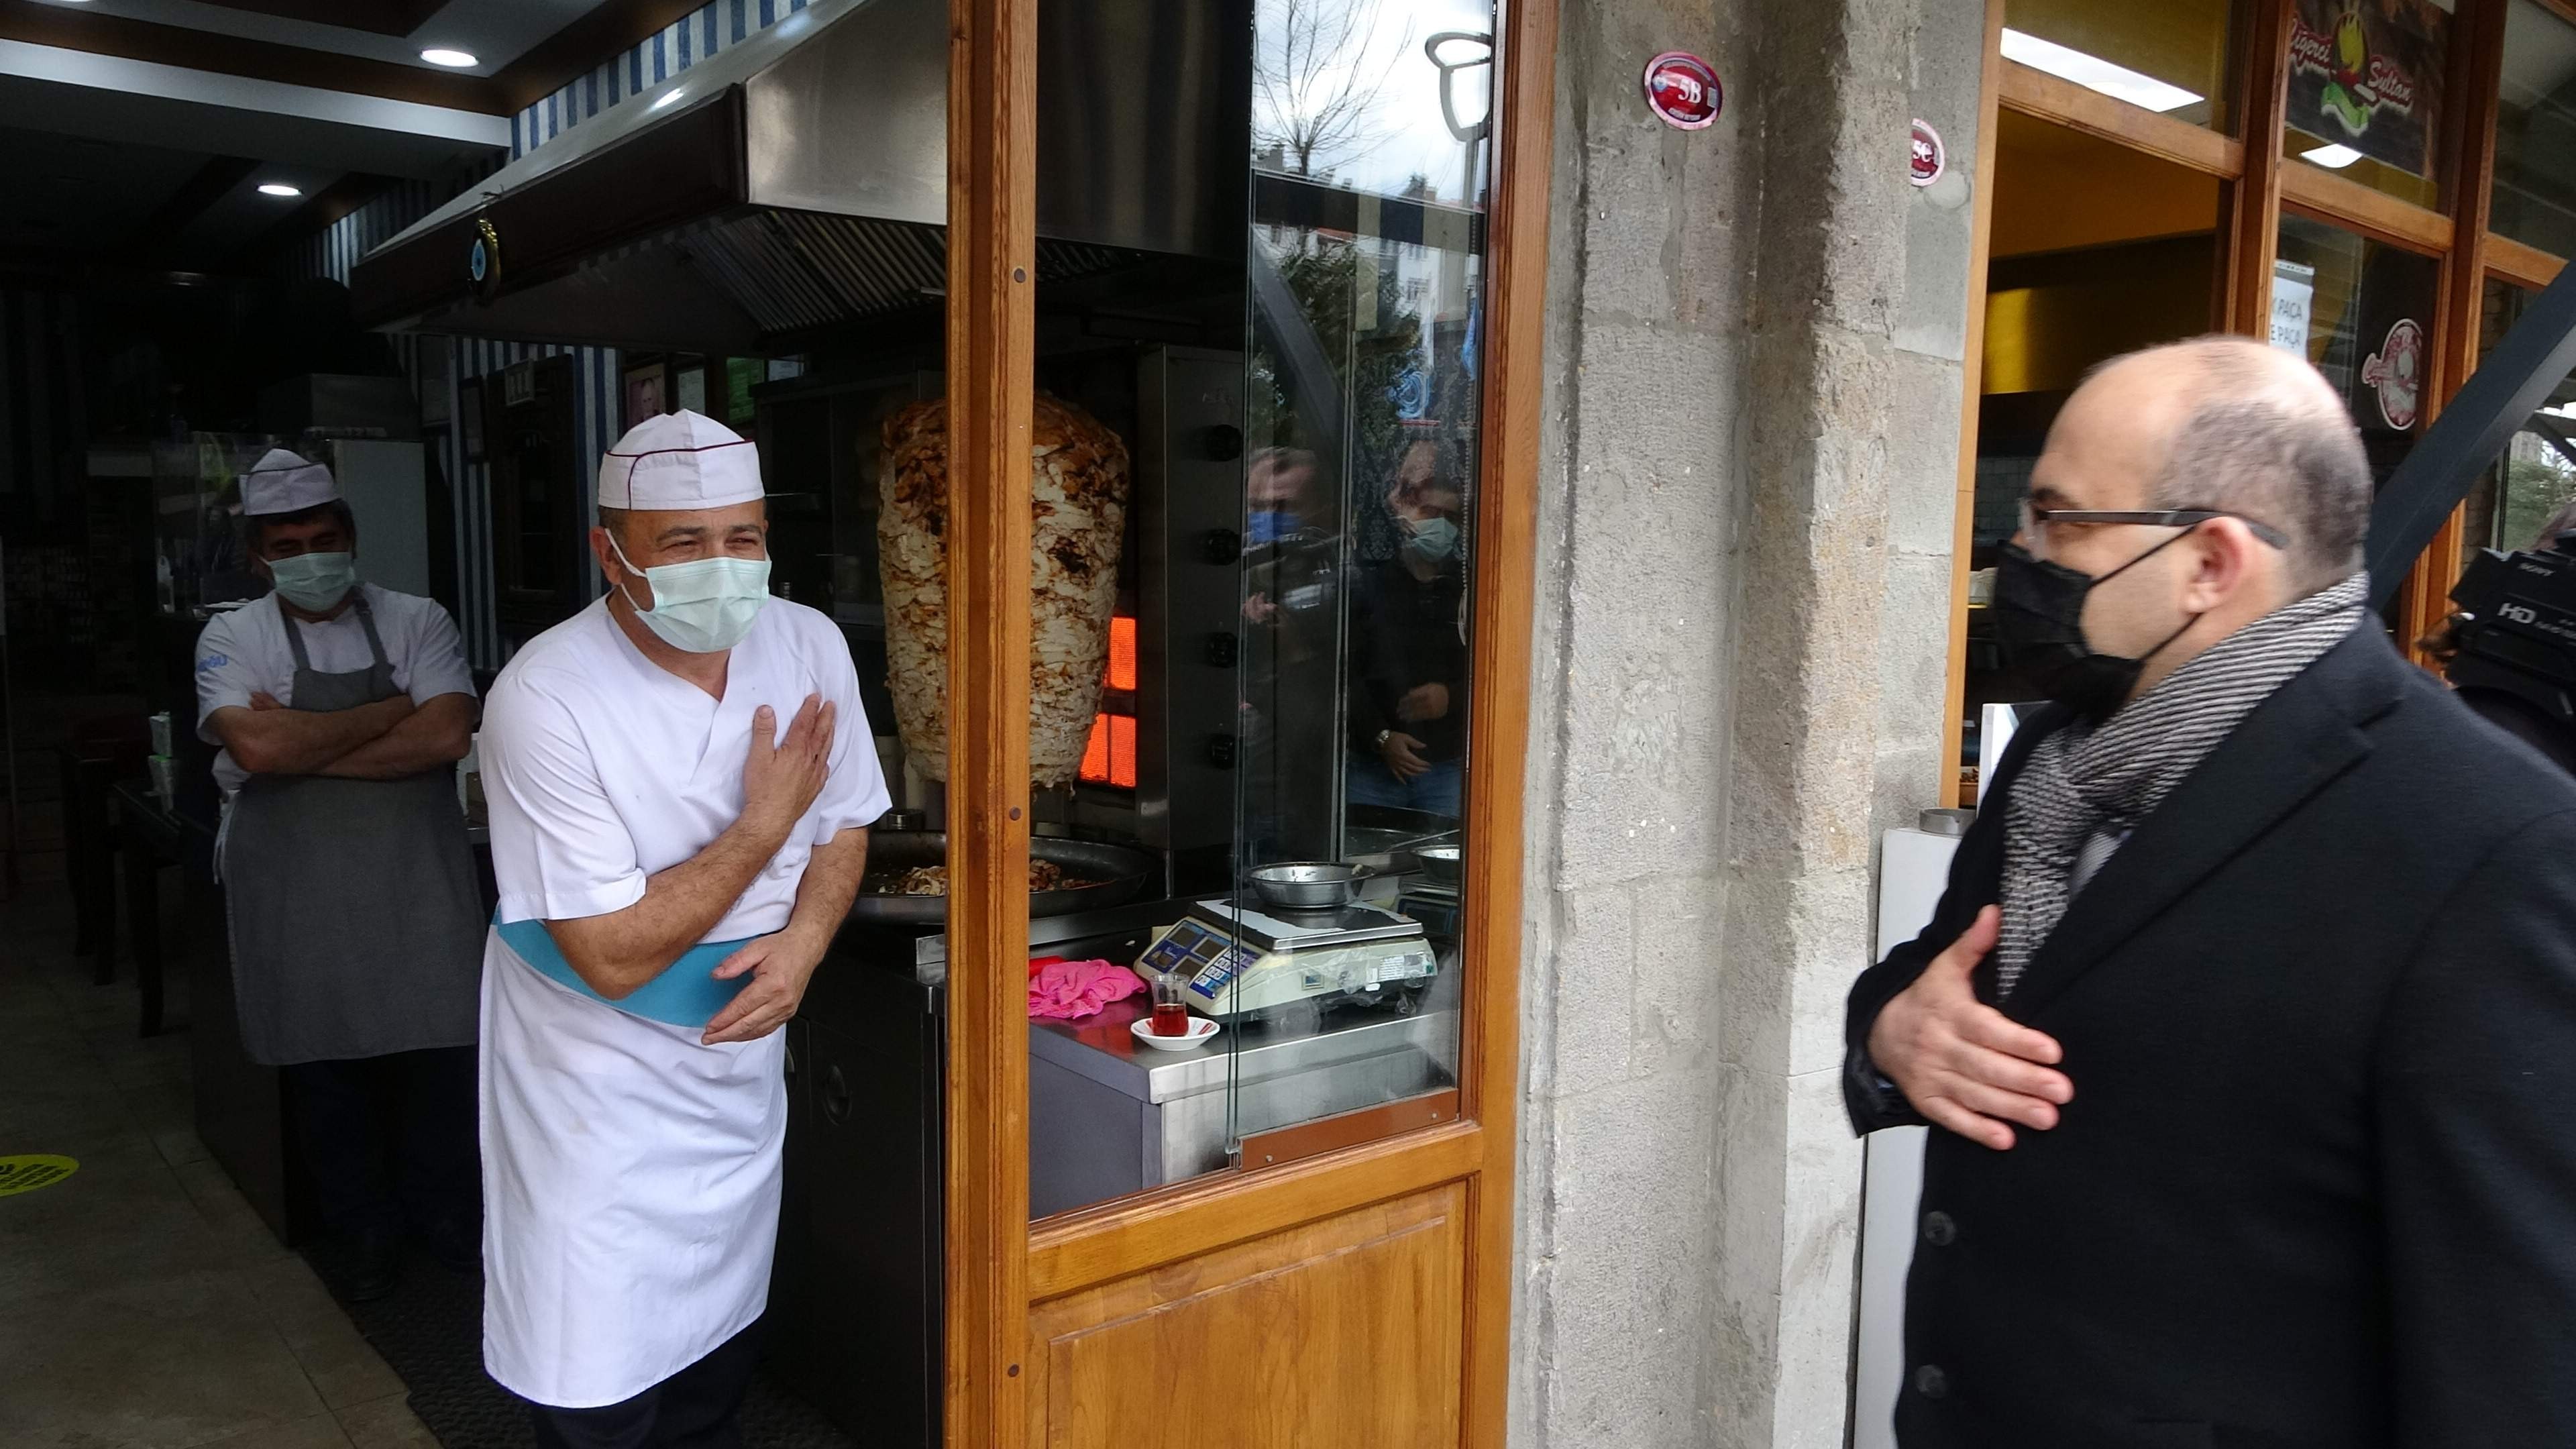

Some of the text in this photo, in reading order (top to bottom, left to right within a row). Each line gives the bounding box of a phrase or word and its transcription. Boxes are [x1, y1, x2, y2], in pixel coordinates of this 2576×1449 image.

[1678, 78, 1702, 104] 5B
[2367, 61, 2411, 101] Sultan
[2496, 602, 2538, 625] HD
